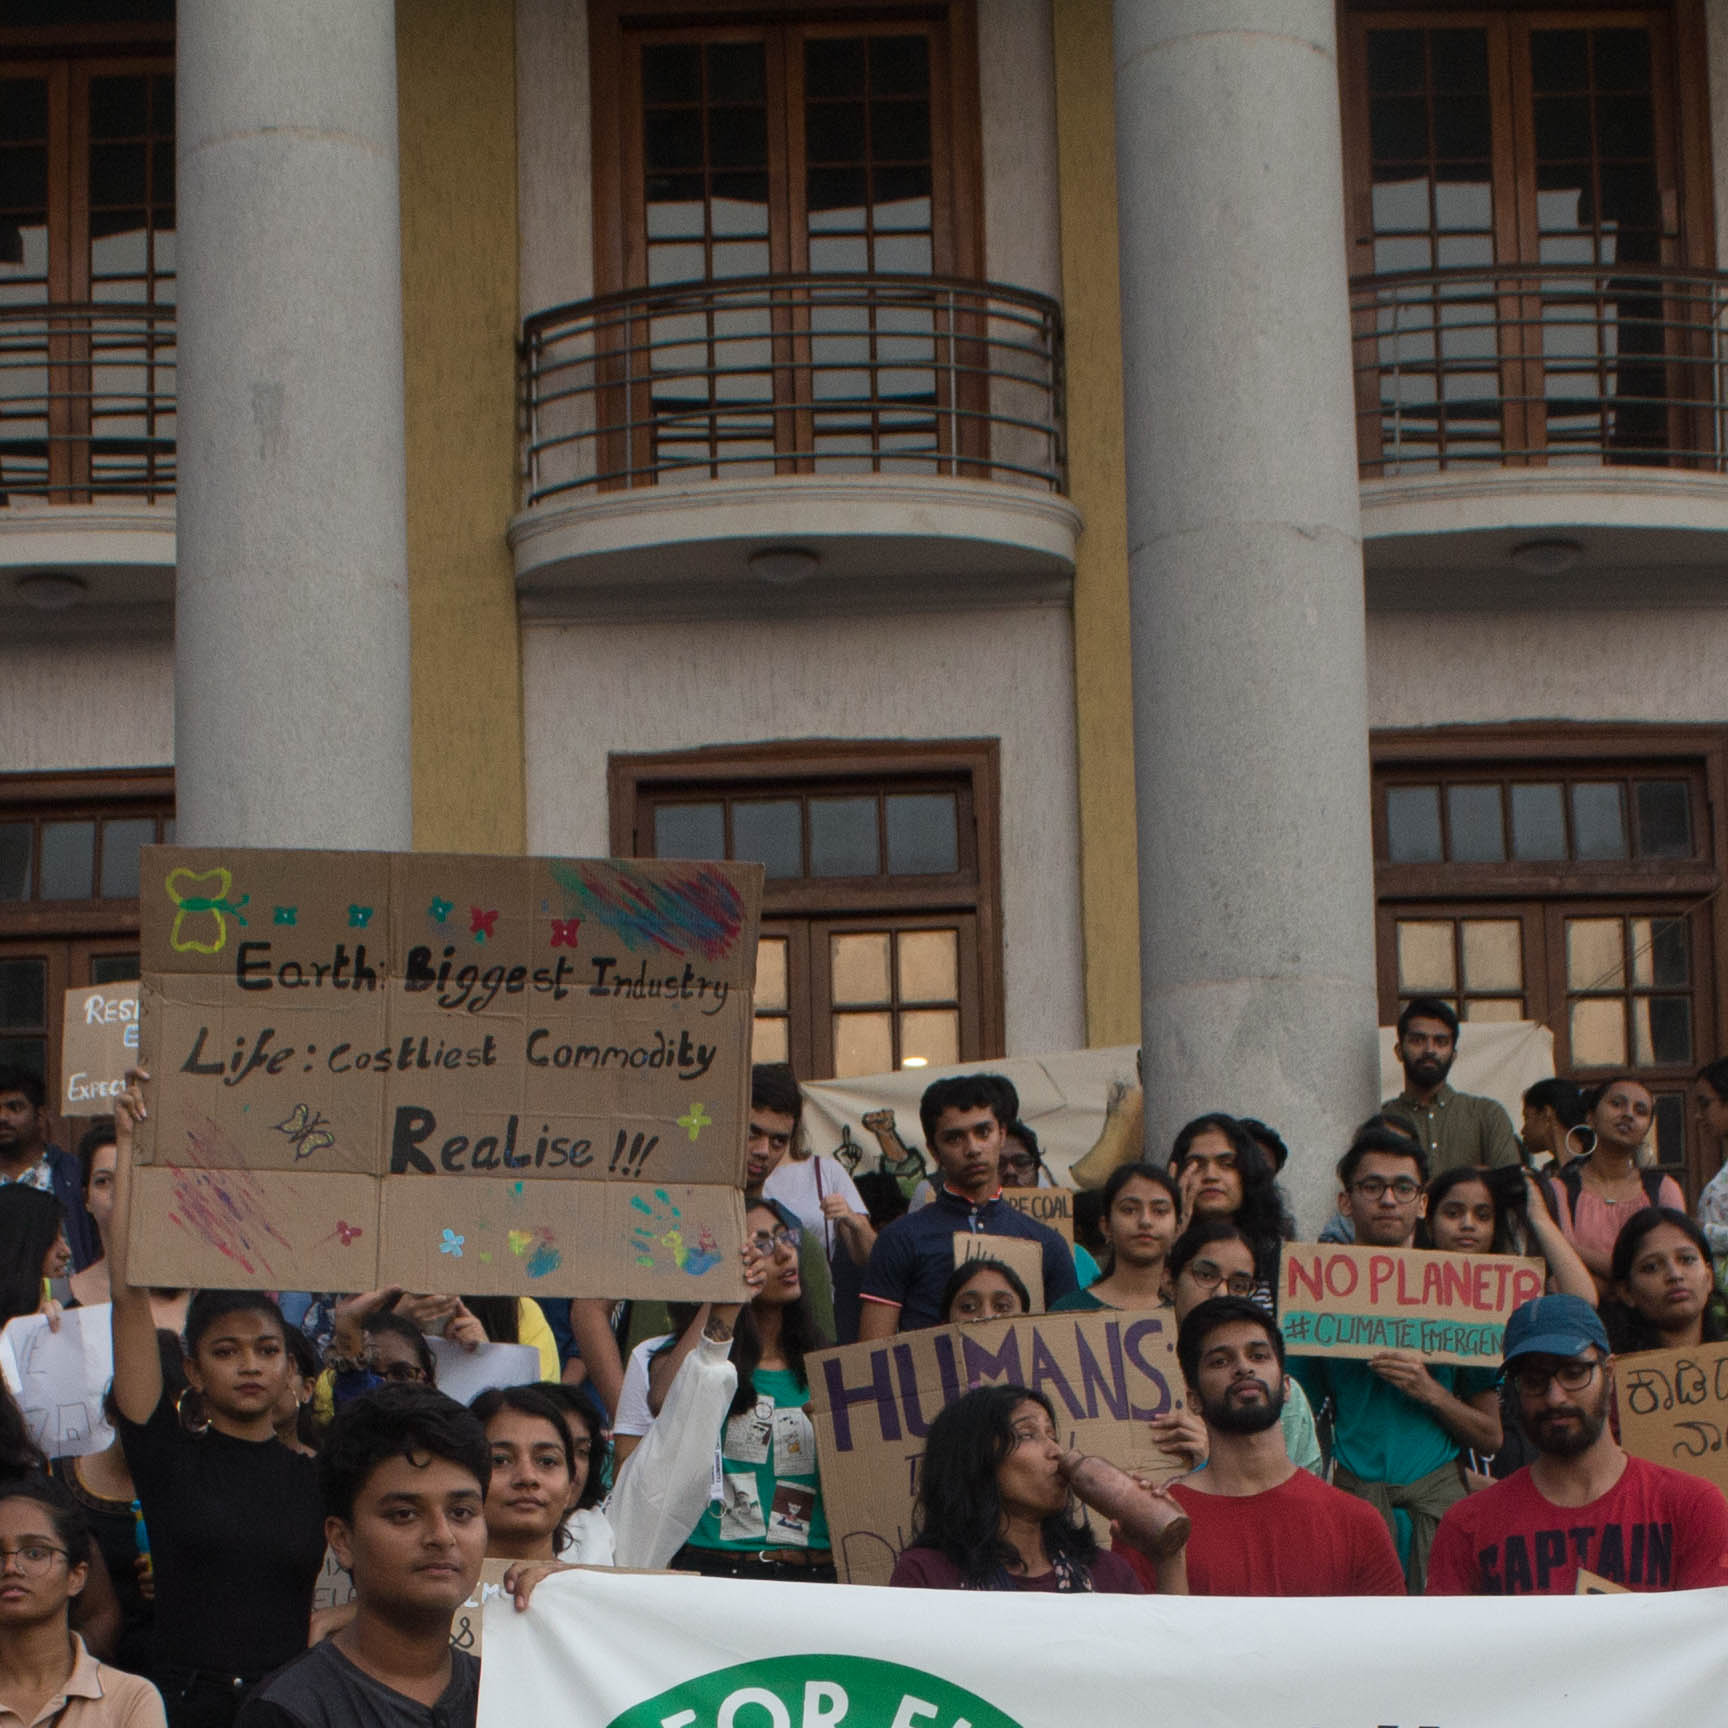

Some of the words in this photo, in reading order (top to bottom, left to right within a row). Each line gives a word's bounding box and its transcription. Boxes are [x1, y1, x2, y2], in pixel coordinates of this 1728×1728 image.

[236, 940, 385, 991] Earth:
[403, 945, 572, 1012] Biggest
[588, 955, 728, 1015] Industry
[85, 995, 139, 1024] RES
[526, 1028, 717, 1080] Commodity
[1288, 1253, 1359, 1302] NO
[1422, 1319, 1504, 1356] EMERGEN
